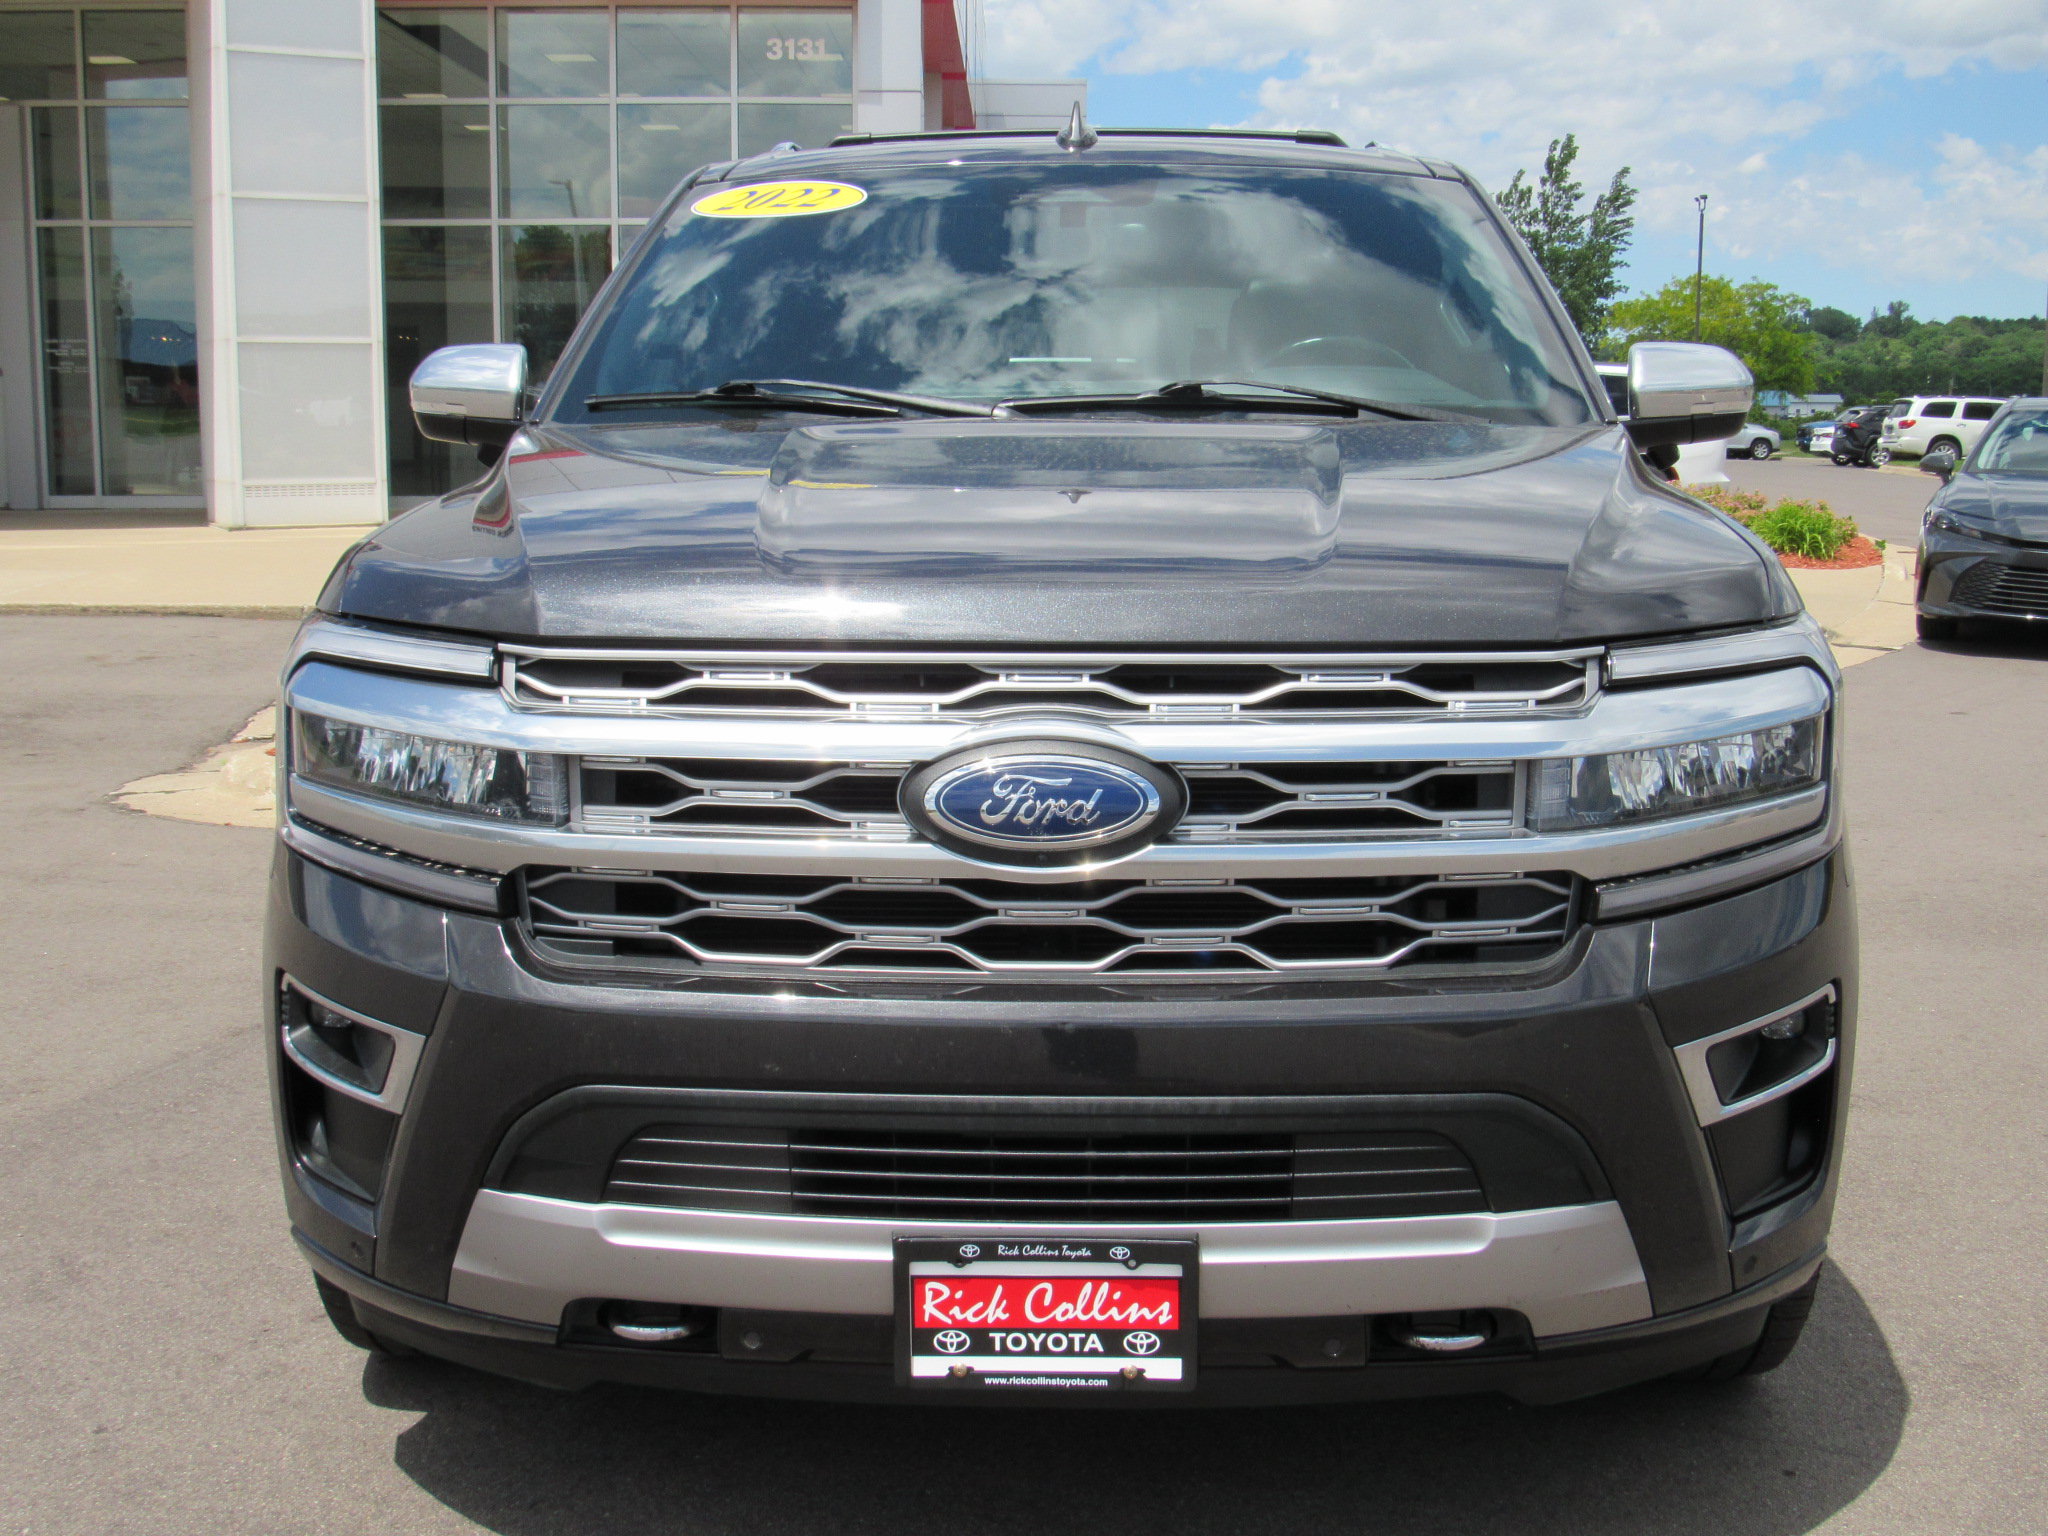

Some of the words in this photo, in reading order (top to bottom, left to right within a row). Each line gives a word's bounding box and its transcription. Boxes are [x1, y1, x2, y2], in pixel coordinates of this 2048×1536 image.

[766, 37, 826, 61] 3131
[711, 187, 842, 211] 2022
[979, 774, 1104, 826] Ford
[997, 1244, 1020, 1257] Rick
[1022, 1244, 1059, 1257] Collins
[1061, 1245, 1092, 1259] Toyota
[922, 1281, 1010, 1324] Rick
[1024, 1281, 1173, 1325] Collins
[989, 1332, 1104, 1353] TOYOTA
[984, 1376, 1109, 1388] www.rickcollinstoyota.com
